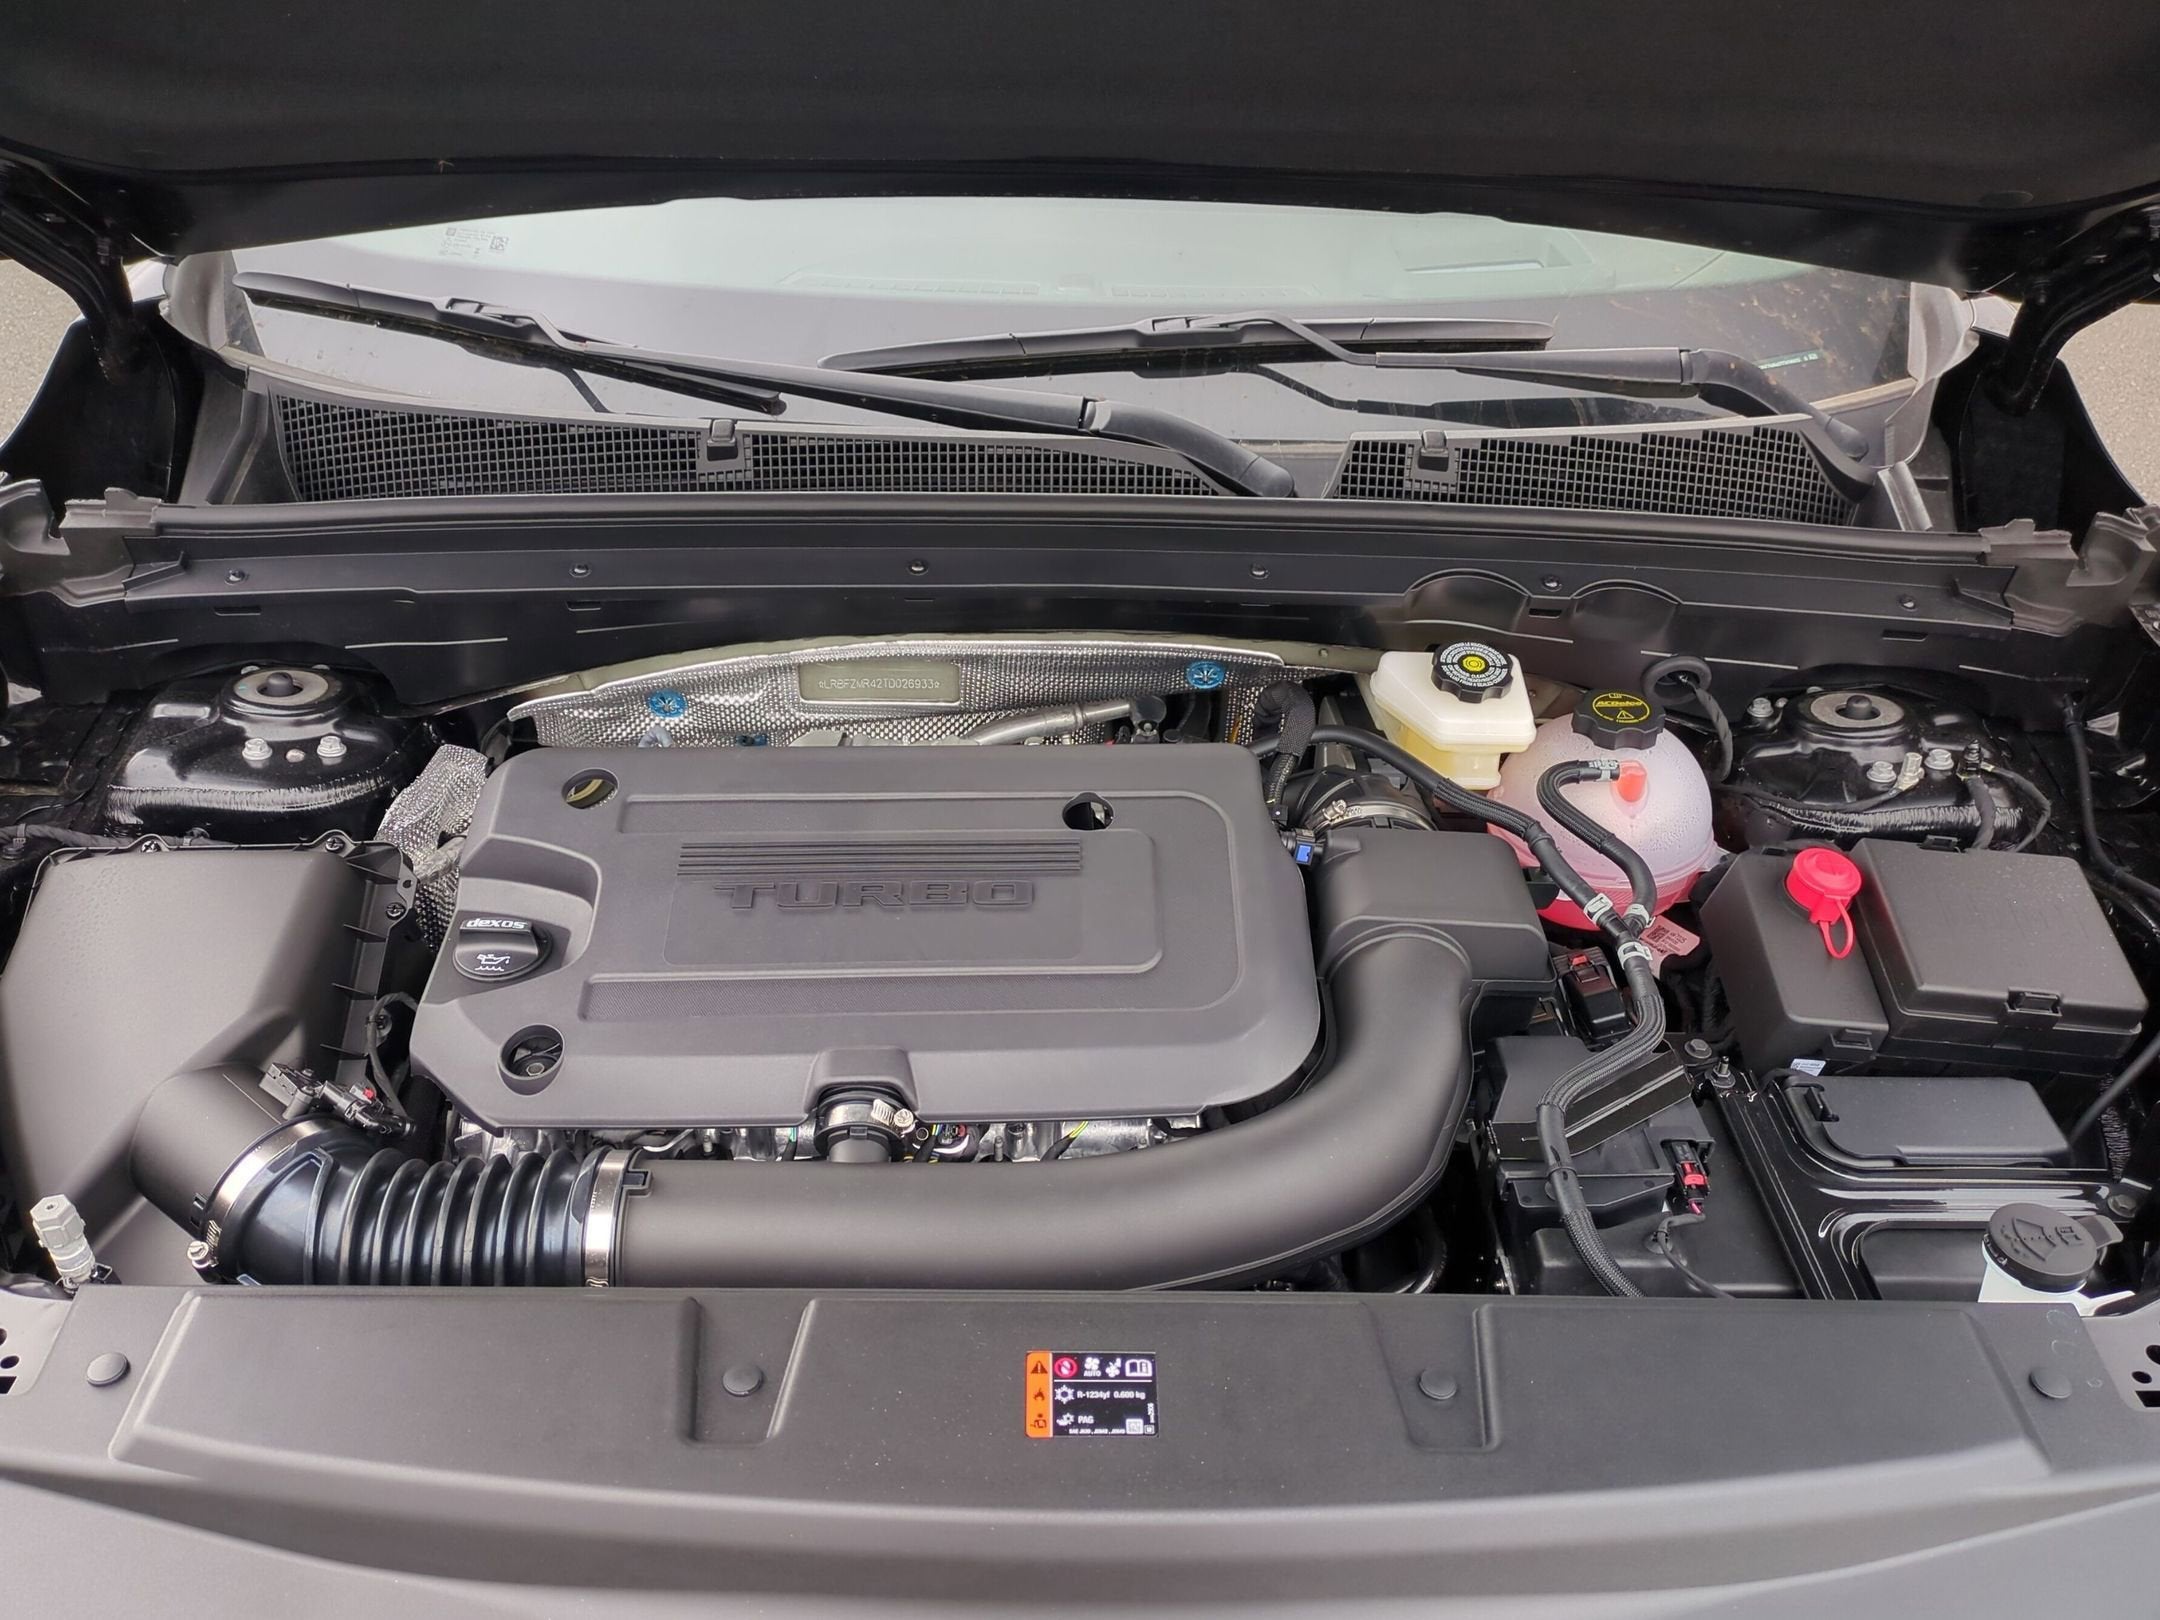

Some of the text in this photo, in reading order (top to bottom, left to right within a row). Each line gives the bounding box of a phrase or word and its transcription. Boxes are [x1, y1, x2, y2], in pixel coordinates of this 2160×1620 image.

[714, 880, 1033, 909] TURBO
[466, 918, 528, 929] dexos
[1076, 1390, 1110, 1400] R-1234yf
[1135, 1390, 1146, 1400] kg
[1077, 1415, 1094, 1424] PAG
